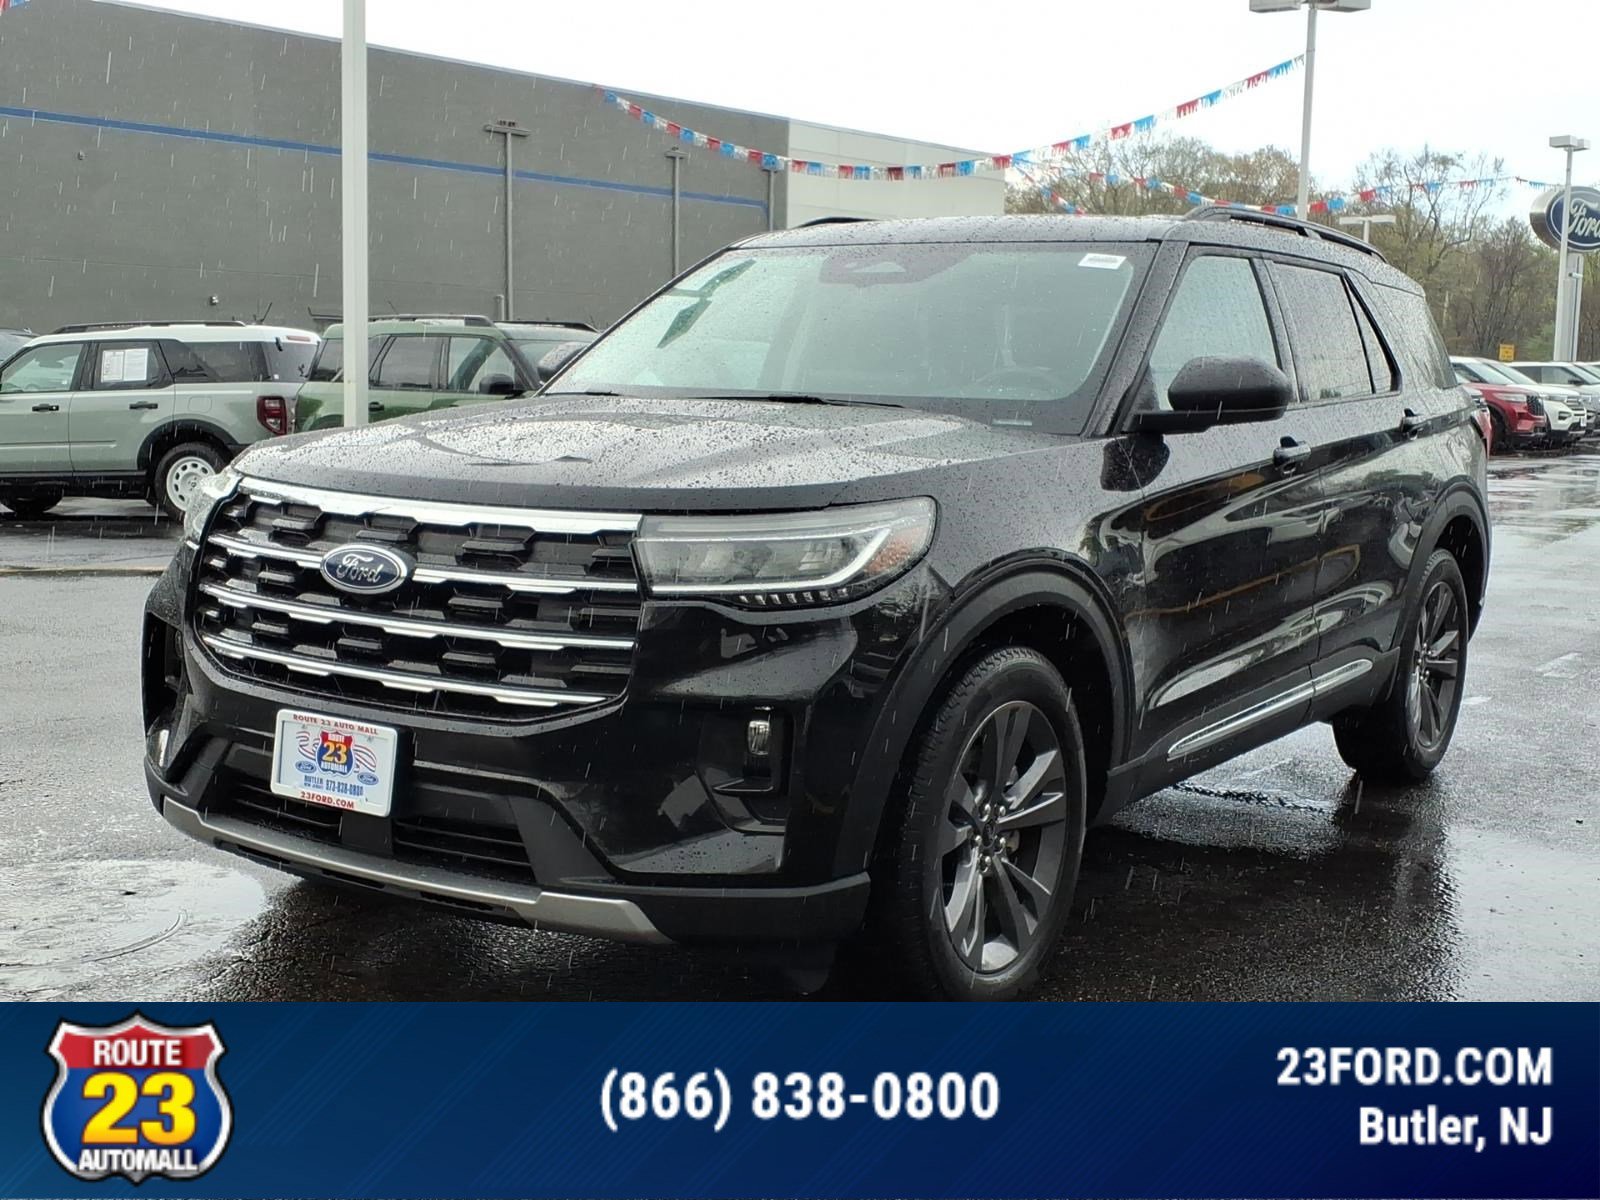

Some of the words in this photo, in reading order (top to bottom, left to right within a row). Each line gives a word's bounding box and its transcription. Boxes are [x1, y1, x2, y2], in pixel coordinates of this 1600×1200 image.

[336, 553, 384, 583] Ford
[293, 714, 318, 724] ROUTE
[321, 719, 331, 727] 23
[334, 721, 355, 731] AUTO
[358, 725, 379, 735] MALL
[322, 741, 347, 765] 23
[300, 791, 355, 809] 23FORD.COM
